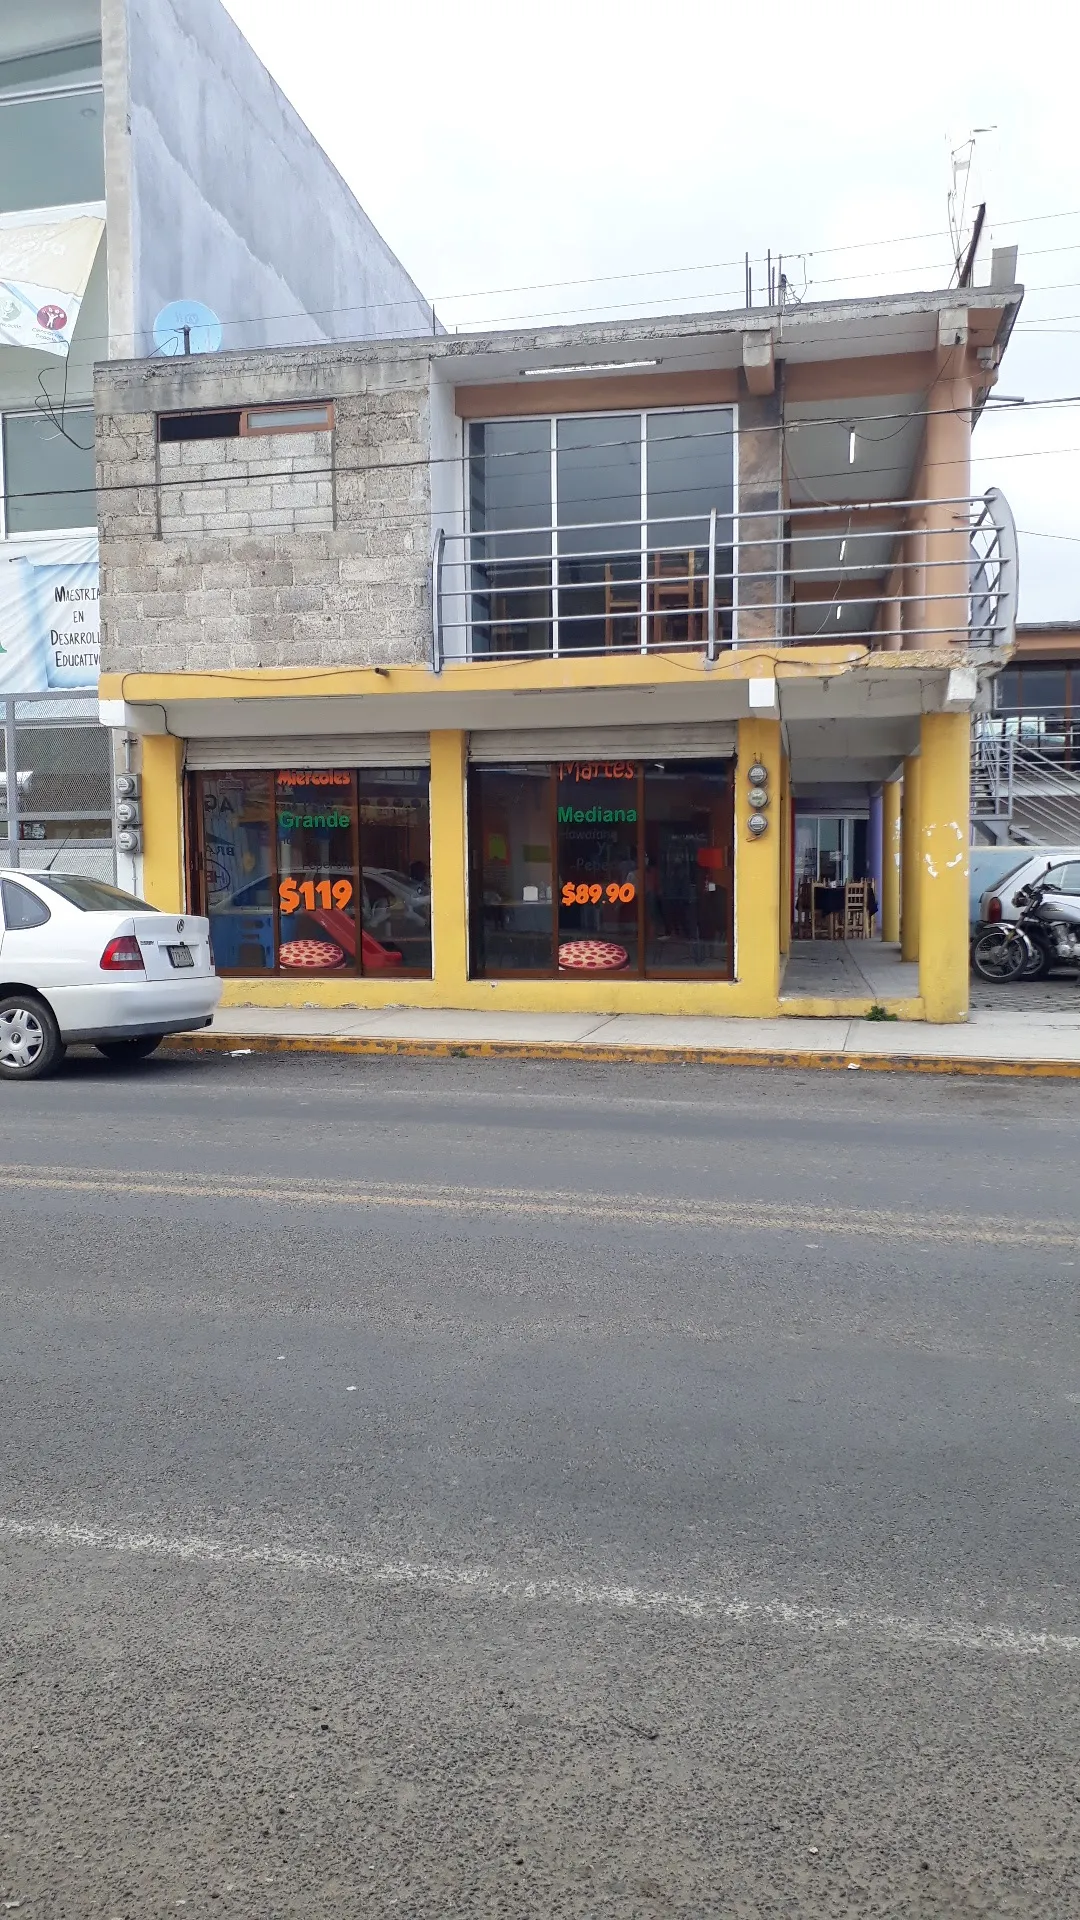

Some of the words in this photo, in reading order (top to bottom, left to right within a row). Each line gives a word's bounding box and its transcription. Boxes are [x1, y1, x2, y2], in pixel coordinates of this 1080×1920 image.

[55, 651, 101, 668] EDUCATIV
[279, 810, 351, 828] Grande
[558, 806, 637, 824] Mediana
[279, 877, 353, 915] $119
[562, 882, 636, 907] $89.90
